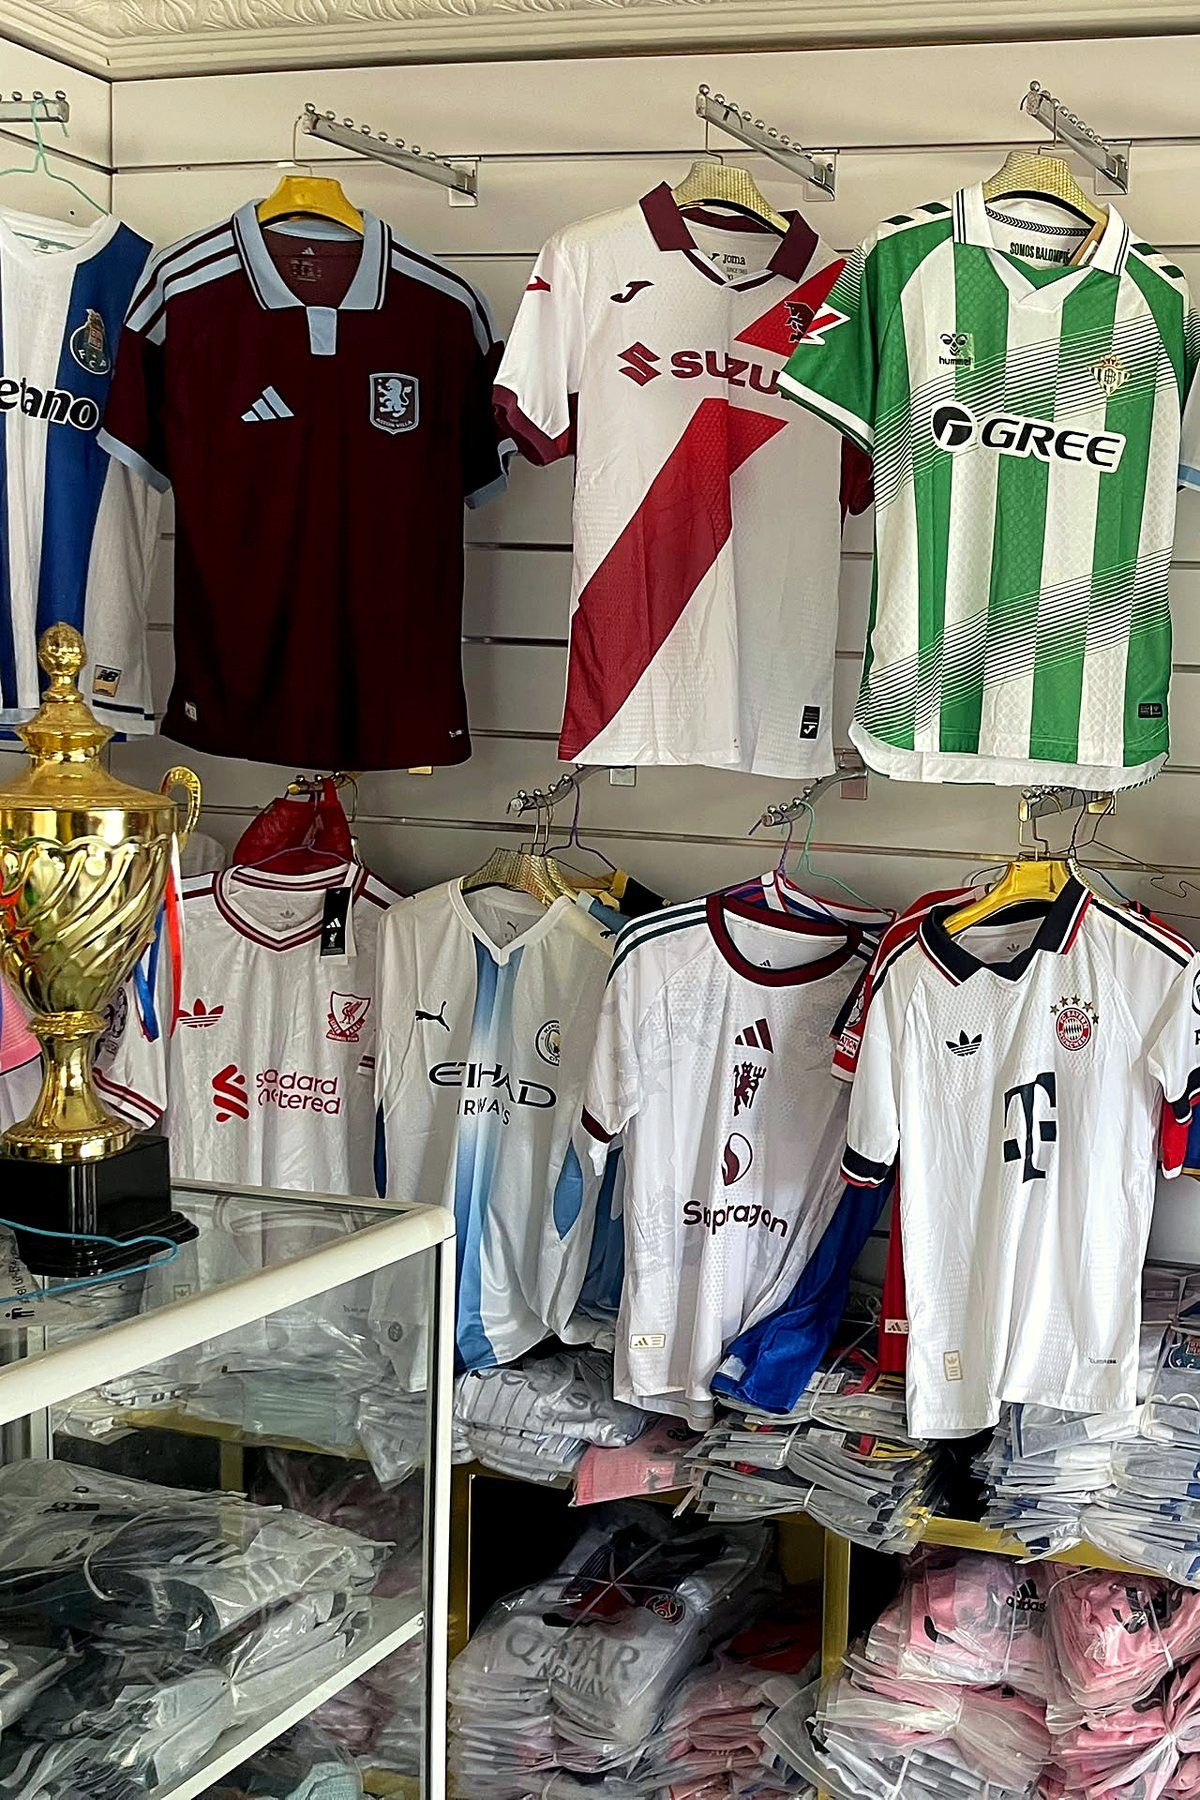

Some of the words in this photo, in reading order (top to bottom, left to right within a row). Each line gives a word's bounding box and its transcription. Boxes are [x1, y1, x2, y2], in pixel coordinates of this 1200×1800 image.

[1010, 242, 1034, 258] SOMOS
[671, 350, 790, 401] SUZU
[939, 356, 971, 366] hummel
[0, 377, 98, 429] etano
[981, 418, 1121, 467] GREE
